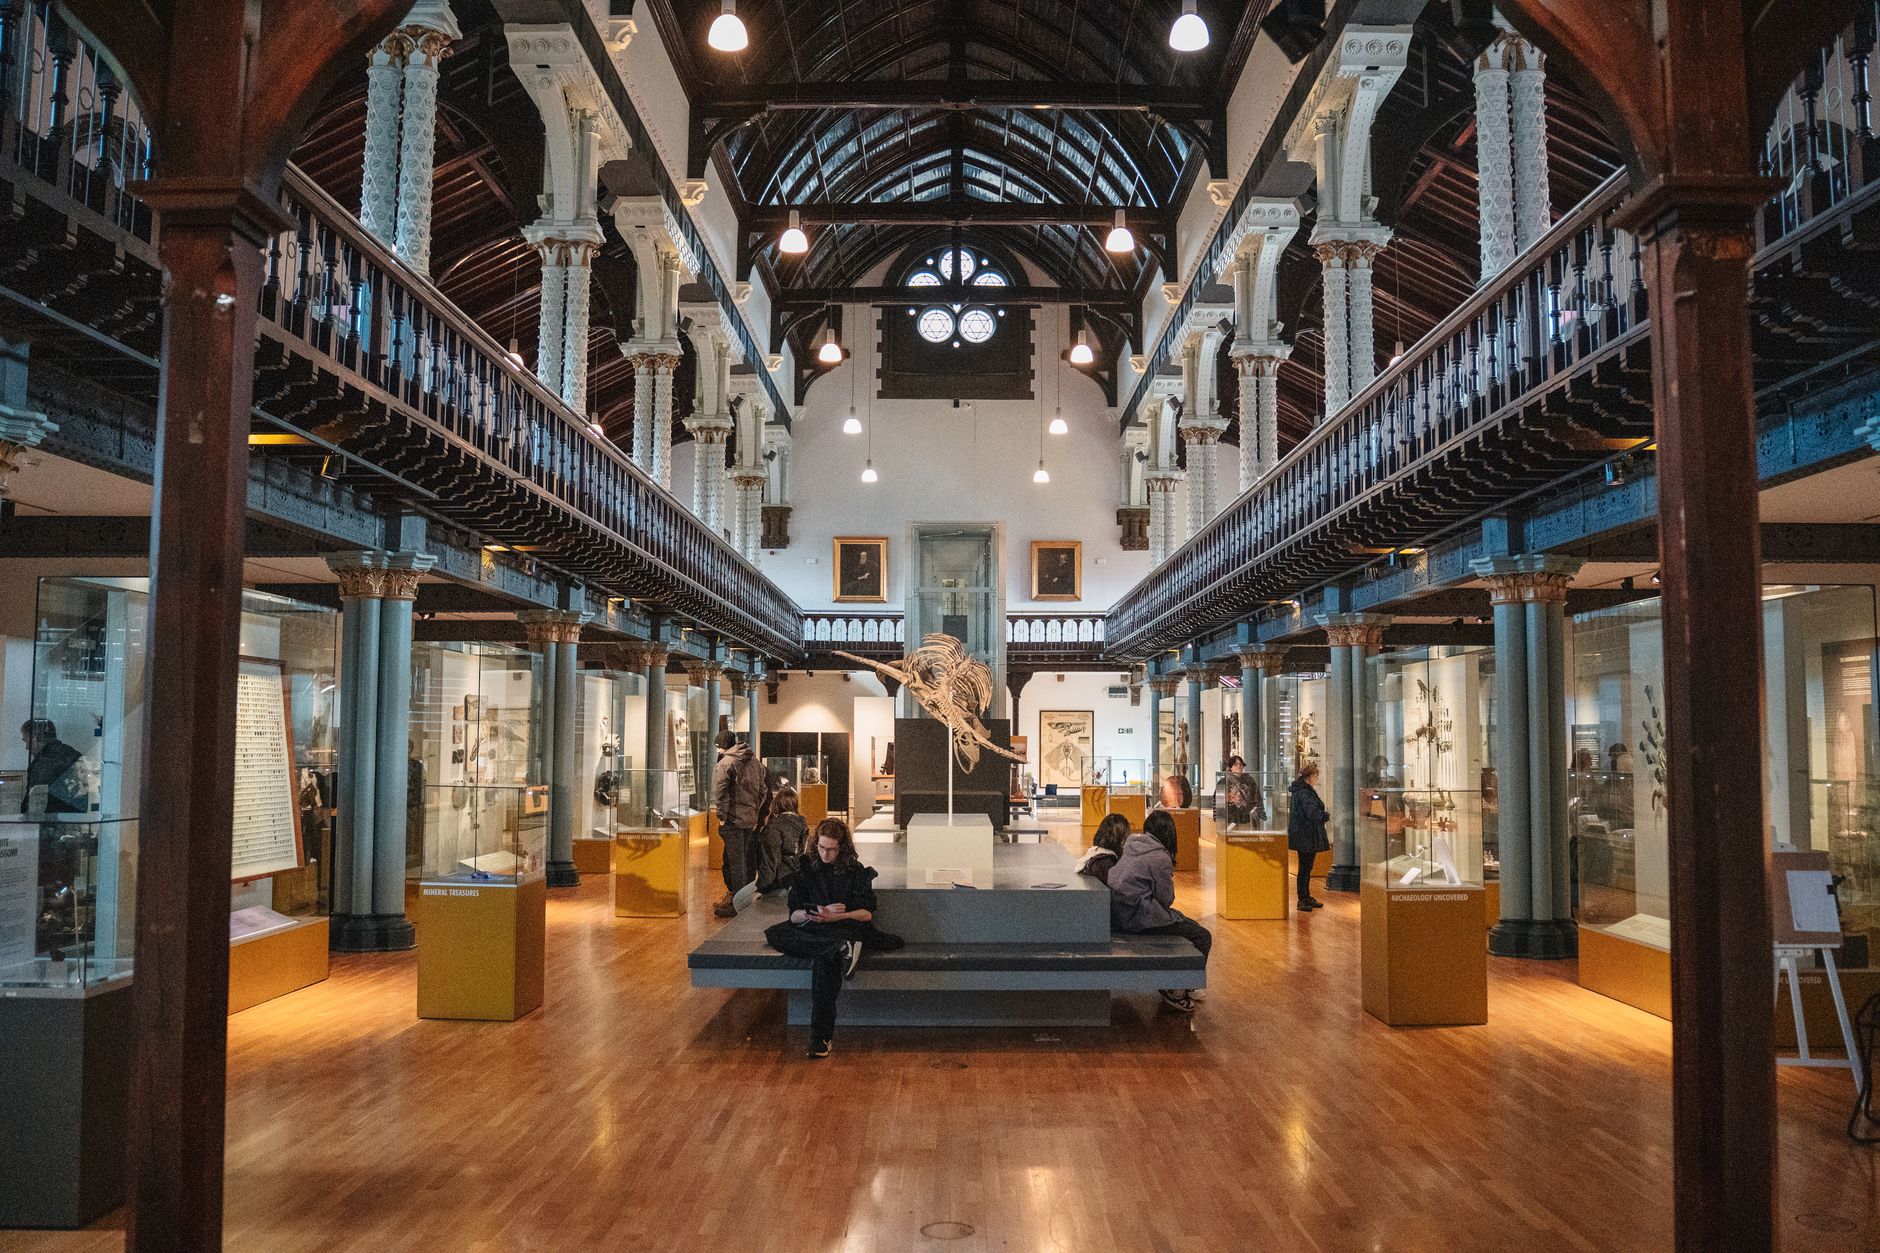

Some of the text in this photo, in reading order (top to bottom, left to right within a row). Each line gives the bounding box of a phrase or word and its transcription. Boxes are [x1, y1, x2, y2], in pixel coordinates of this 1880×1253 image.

[423, 888, 480, 897] MINERAL TREASURES
[1433, 893, 1469, 901] UNCOVERED
